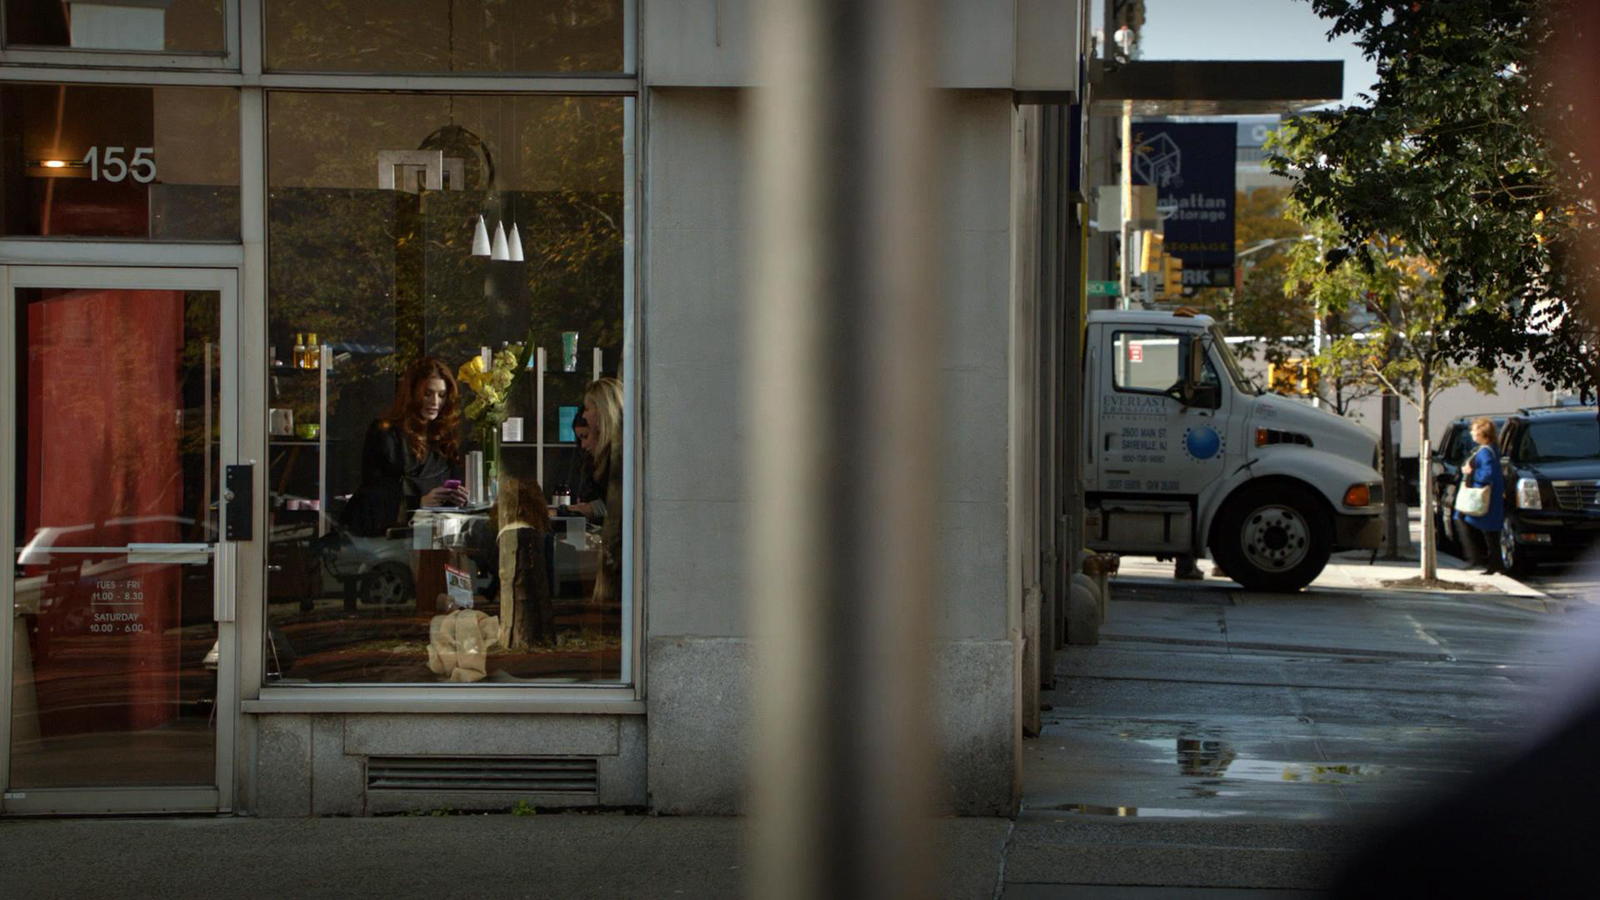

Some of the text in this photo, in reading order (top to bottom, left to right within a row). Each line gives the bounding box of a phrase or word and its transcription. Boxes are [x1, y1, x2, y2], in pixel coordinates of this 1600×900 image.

[83, 146, 157, 183] 155
[1158, 193, 1226, 208] nhattan
[1103, 395, 1167, 407] EVERLAST
[1141, 428, 1156, 438] MAIN
[96, 580, 116, 589] TUES
[126, 580, 140, 589] FRI
[124, 592, 143, 600] 8.30
[94, 613, 139, 621] SATURDAY
[90, 624, 113, 632] 10.00
[124, 624, 143, 632] 6.00
